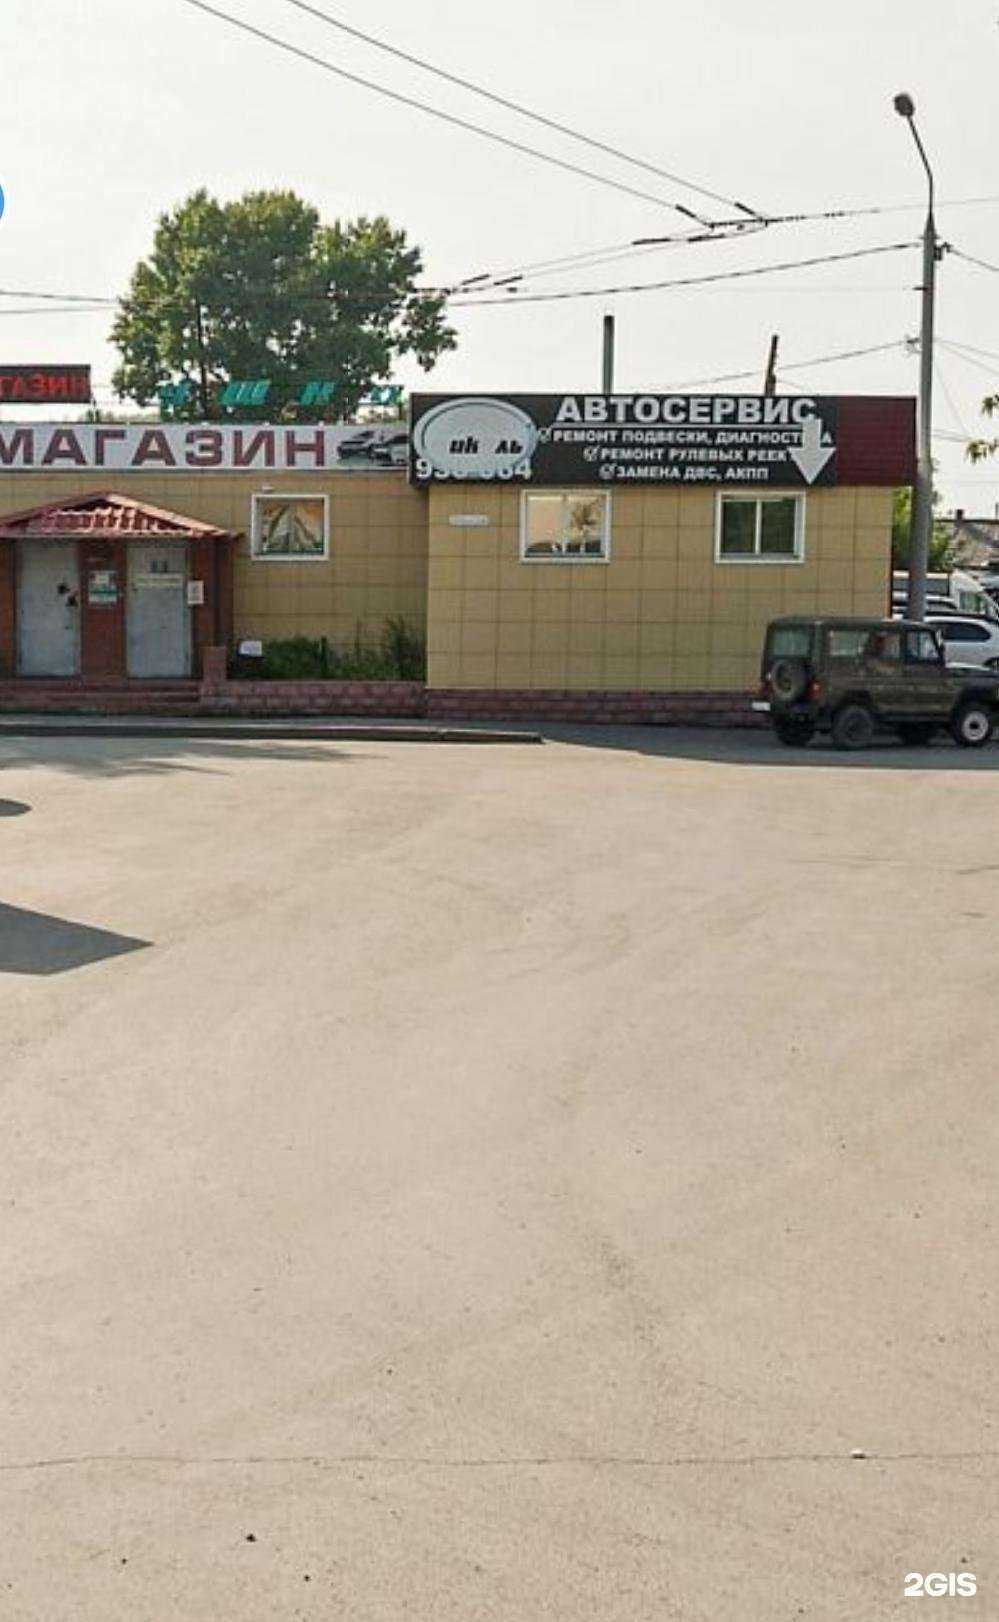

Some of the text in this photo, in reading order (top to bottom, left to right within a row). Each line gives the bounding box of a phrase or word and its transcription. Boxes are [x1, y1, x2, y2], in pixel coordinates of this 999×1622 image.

[555, 396, 817, 424] АВТОСЕРВИС
[553, 429, 618, 442] РЕМОНТ
[715, 431, 832, 444] ДИАГНОСТА
[0, 429, 325, 467] МАГАЗИН
[601, 447, 788, 461] РЕМОНТ РУЛЕВЫХ РЕЕК
[616, 465, 681, 478] ЗАМЕНА
[726, 467, 769, 480] АКПП
